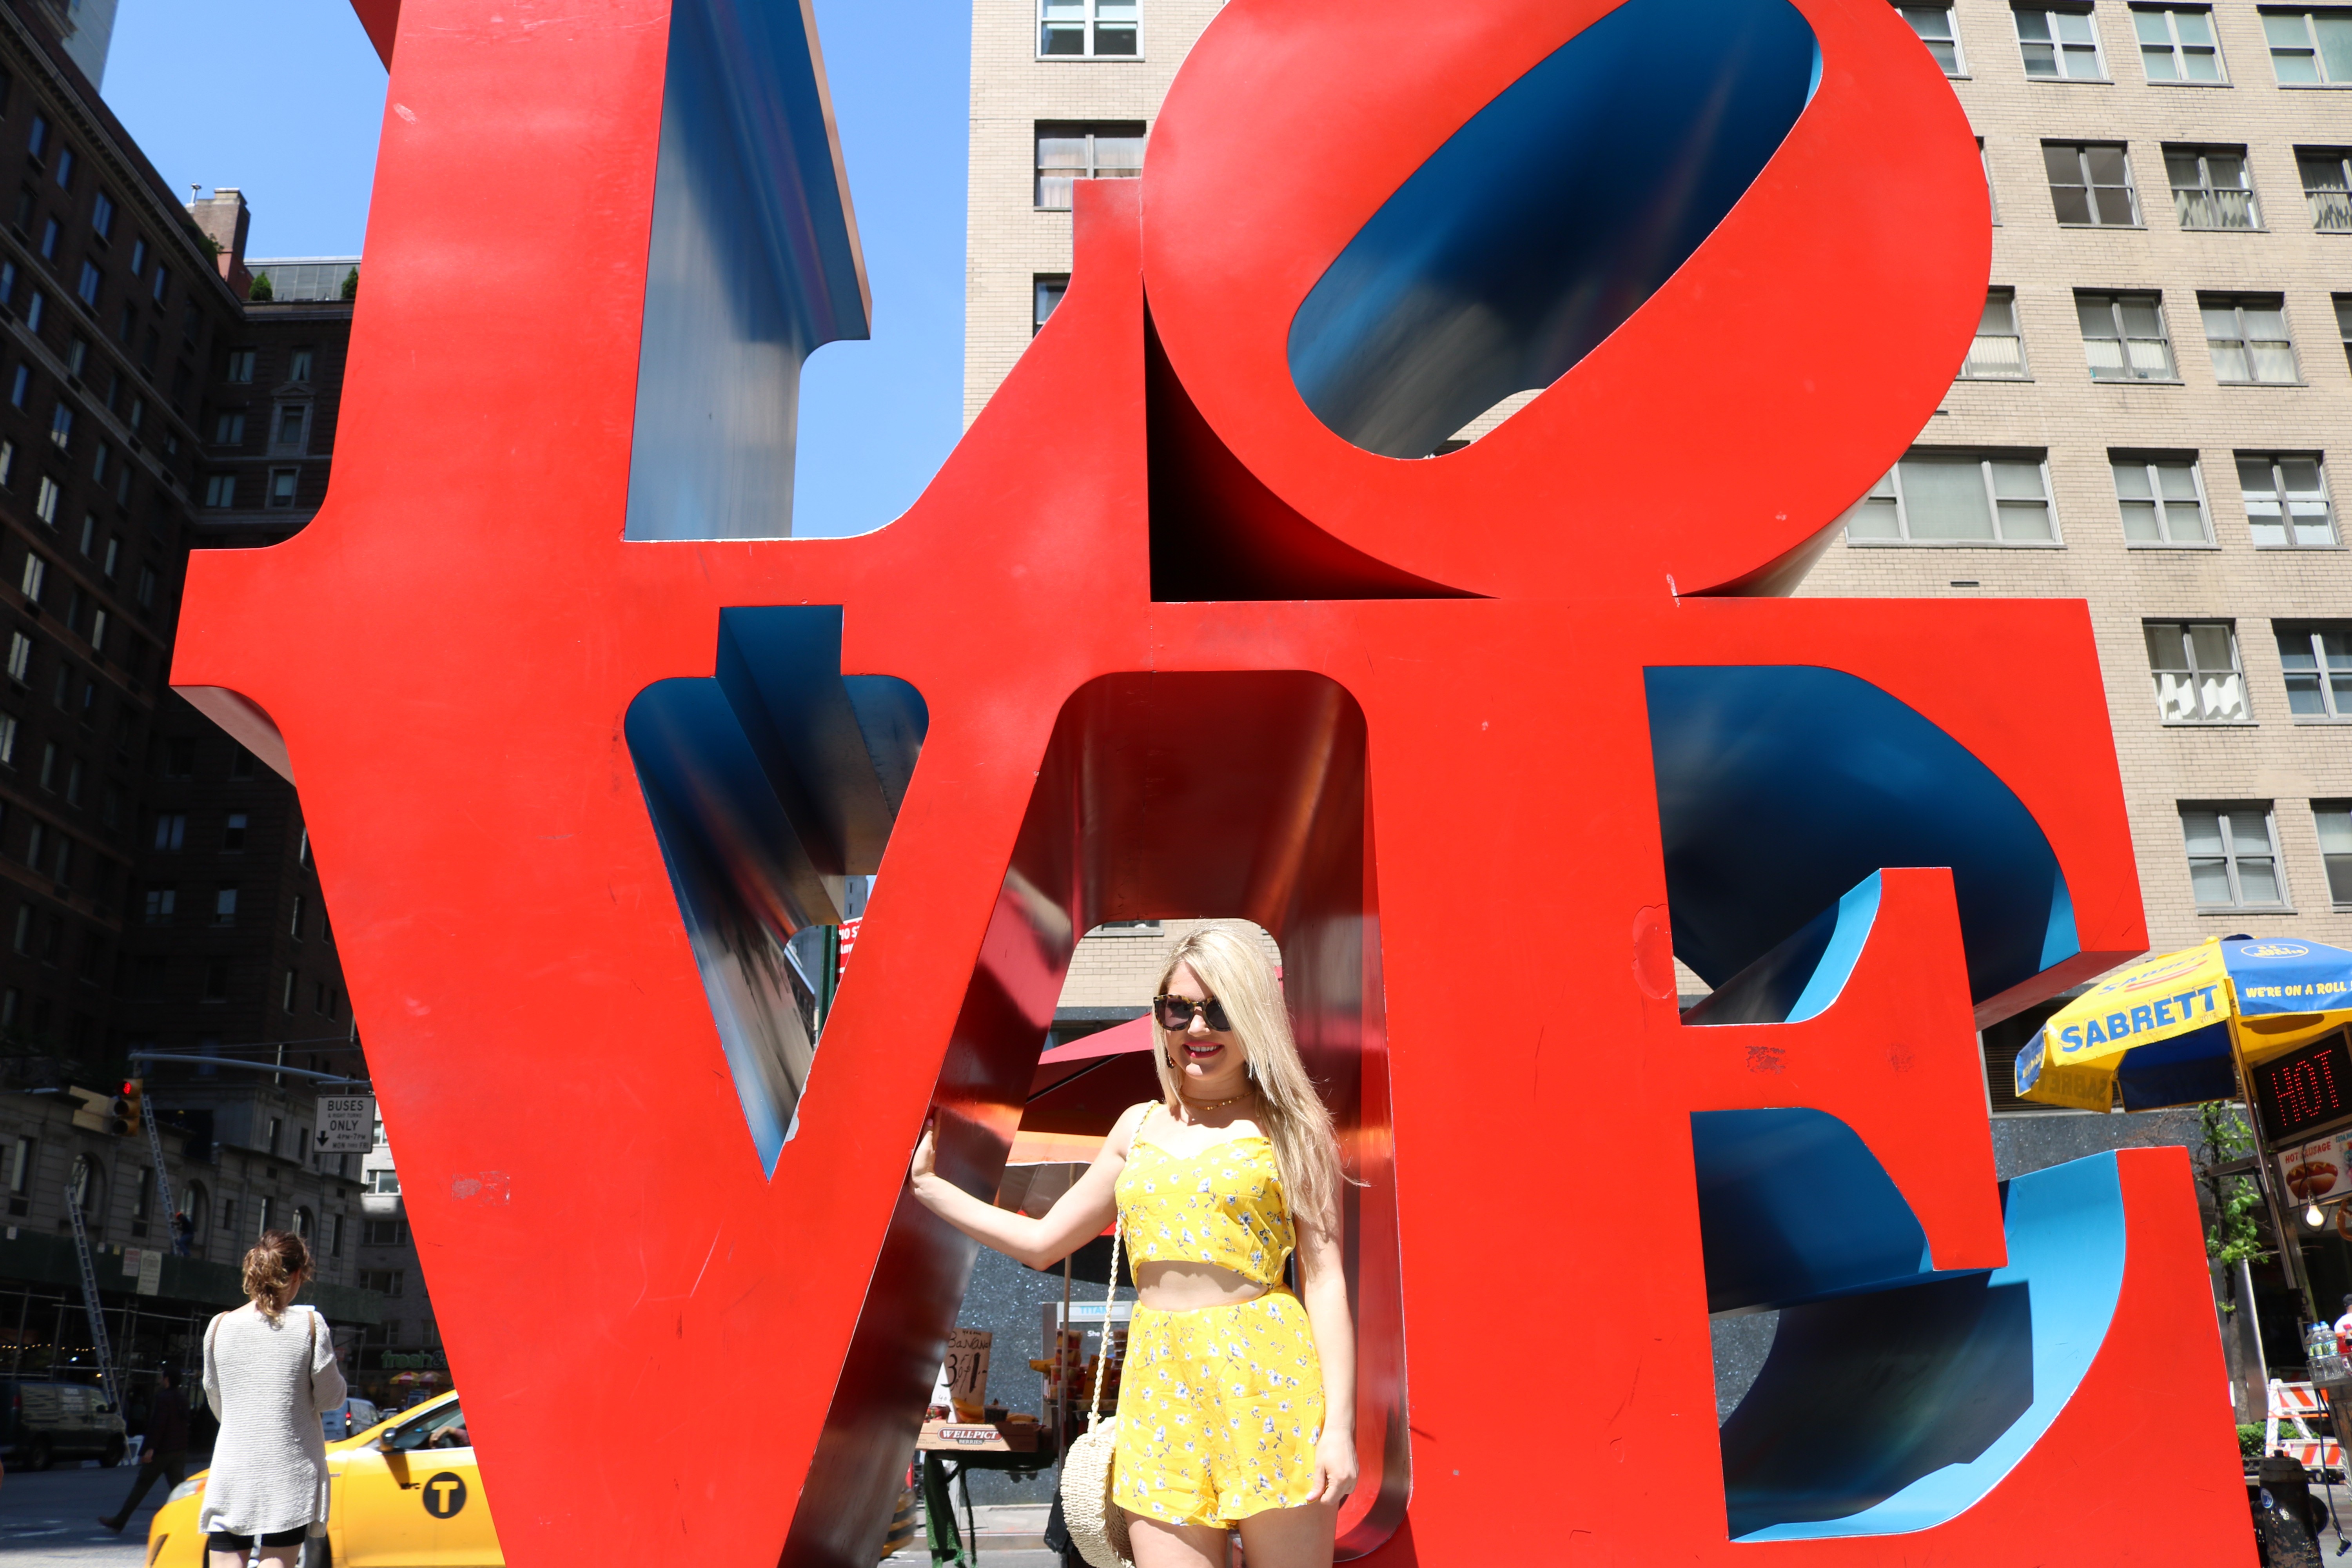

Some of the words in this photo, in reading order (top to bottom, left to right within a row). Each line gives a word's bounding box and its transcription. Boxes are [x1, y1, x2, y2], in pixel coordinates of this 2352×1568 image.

[2098, 951, 2212, 995] SABRETT
[2245, 986, 2281, 998] WE'RE
[2285, 985, 2302, 996] ON
[2305, 984, 2313, 995] A
[2316, 982, 2347, 995] ROLL
[2058, 981, 2218, 1053] SABRETT
[2272, 1049, 2340, 1126] HOT
[328, 1100, 363, 1111] BUSES
[330, 1120, 358, 1131] ONLY
[2285, 1152, 2299, 1164] HOT
[432, 1481, 459, 1513] T
